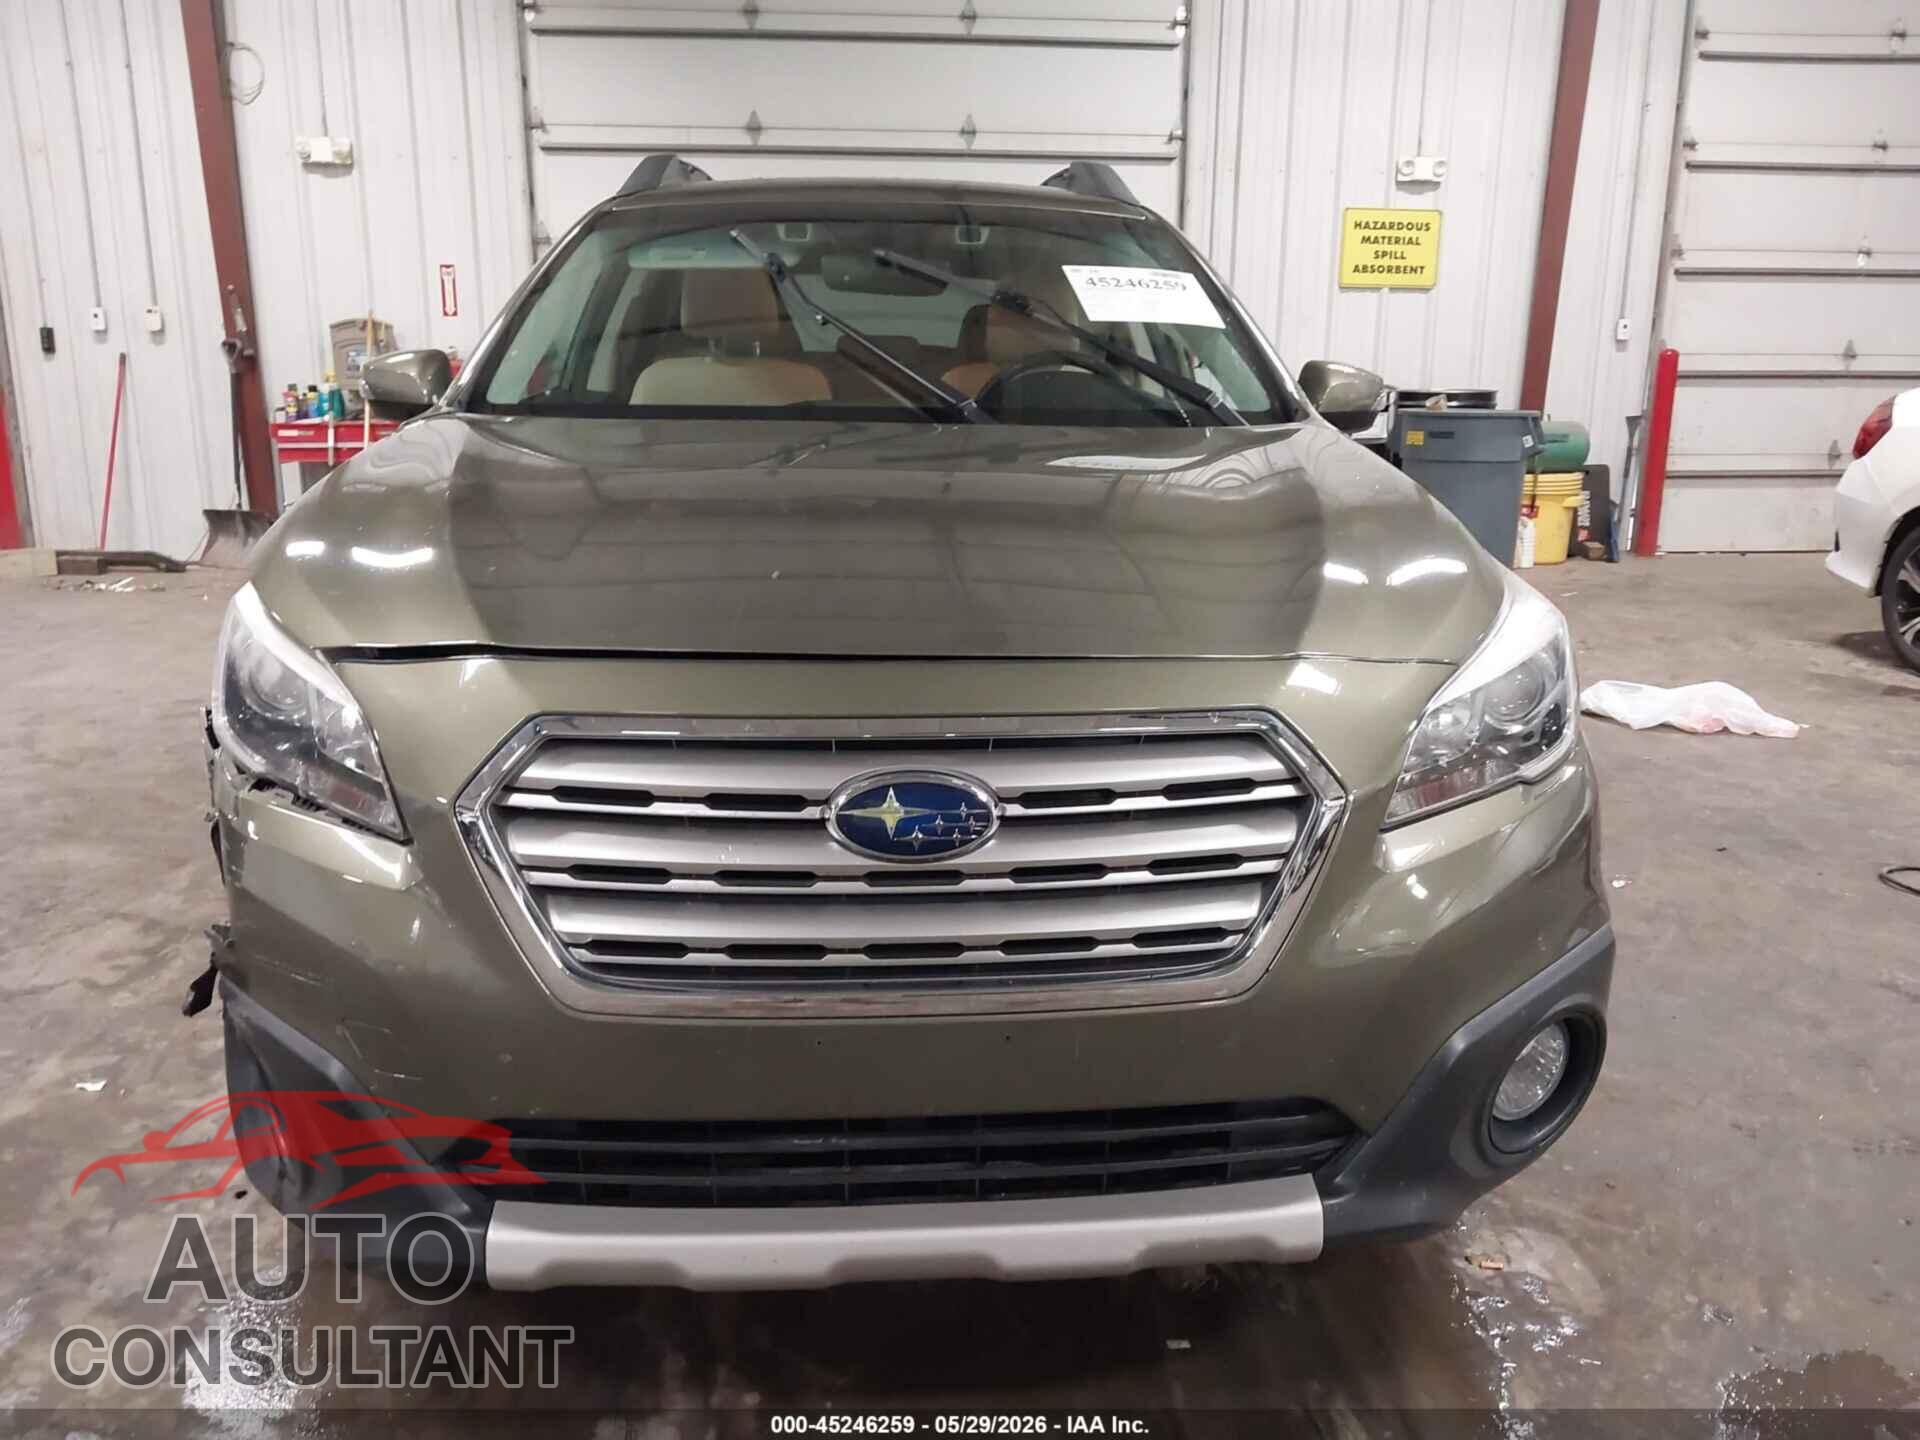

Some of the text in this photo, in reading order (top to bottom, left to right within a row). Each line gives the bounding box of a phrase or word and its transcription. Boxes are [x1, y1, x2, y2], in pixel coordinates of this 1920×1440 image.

[1353, 220, 1432, 232] HAZARDOUS
[1360, 235, 1422, 246] MATERIAL
[1373, 250, 1407, 260] SPILL
[1352, 264, 1426, 275] ABSORBENT
[1085, 276, 1188, 292] 45246259
